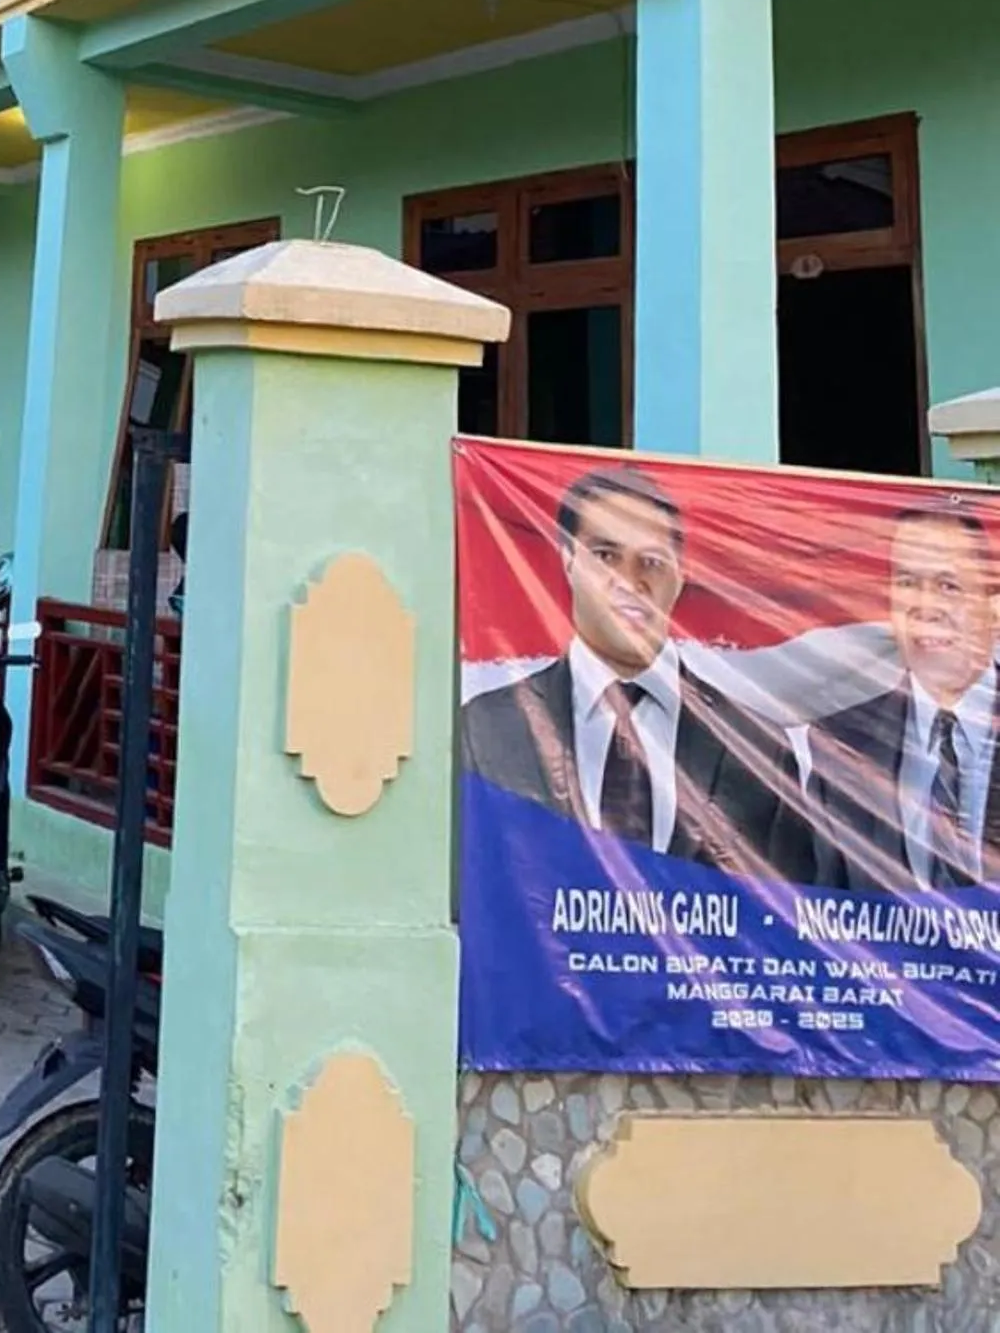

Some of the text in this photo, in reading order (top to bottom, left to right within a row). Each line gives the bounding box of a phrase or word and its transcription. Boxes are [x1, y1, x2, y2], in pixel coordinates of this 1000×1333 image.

[552, 887, 667, 935] ADRIANUS
[672, 891, 739, 938] GARU
[794, 896, 941, 947] ANGGALINUS
[568, 952, 997, 985] CALON BUPATI DAN WAKIL BUPATI
[667, 982, 904, 1005] MANGGARAI BARAT
[711, 1010, 774, 1029] 2020
[797, 1011, 865, 1030] 2025
